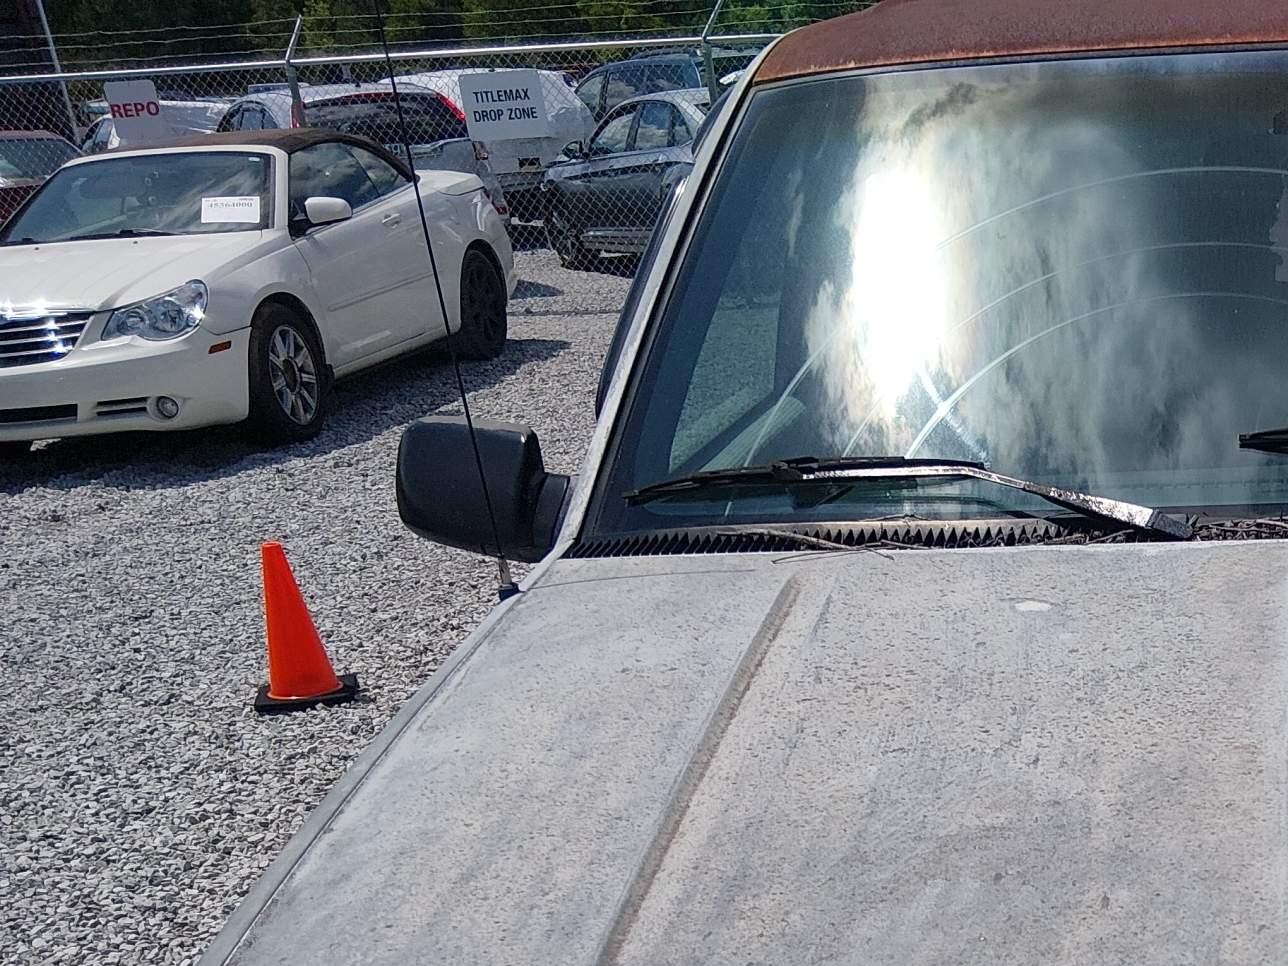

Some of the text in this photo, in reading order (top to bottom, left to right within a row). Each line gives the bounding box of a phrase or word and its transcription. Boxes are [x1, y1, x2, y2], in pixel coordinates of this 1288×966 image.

[473, 88, 530, 103] TITLEMAX
[110, 101, 159, 118] REPO
[473, 107, 538, 122] DROP ZONE
